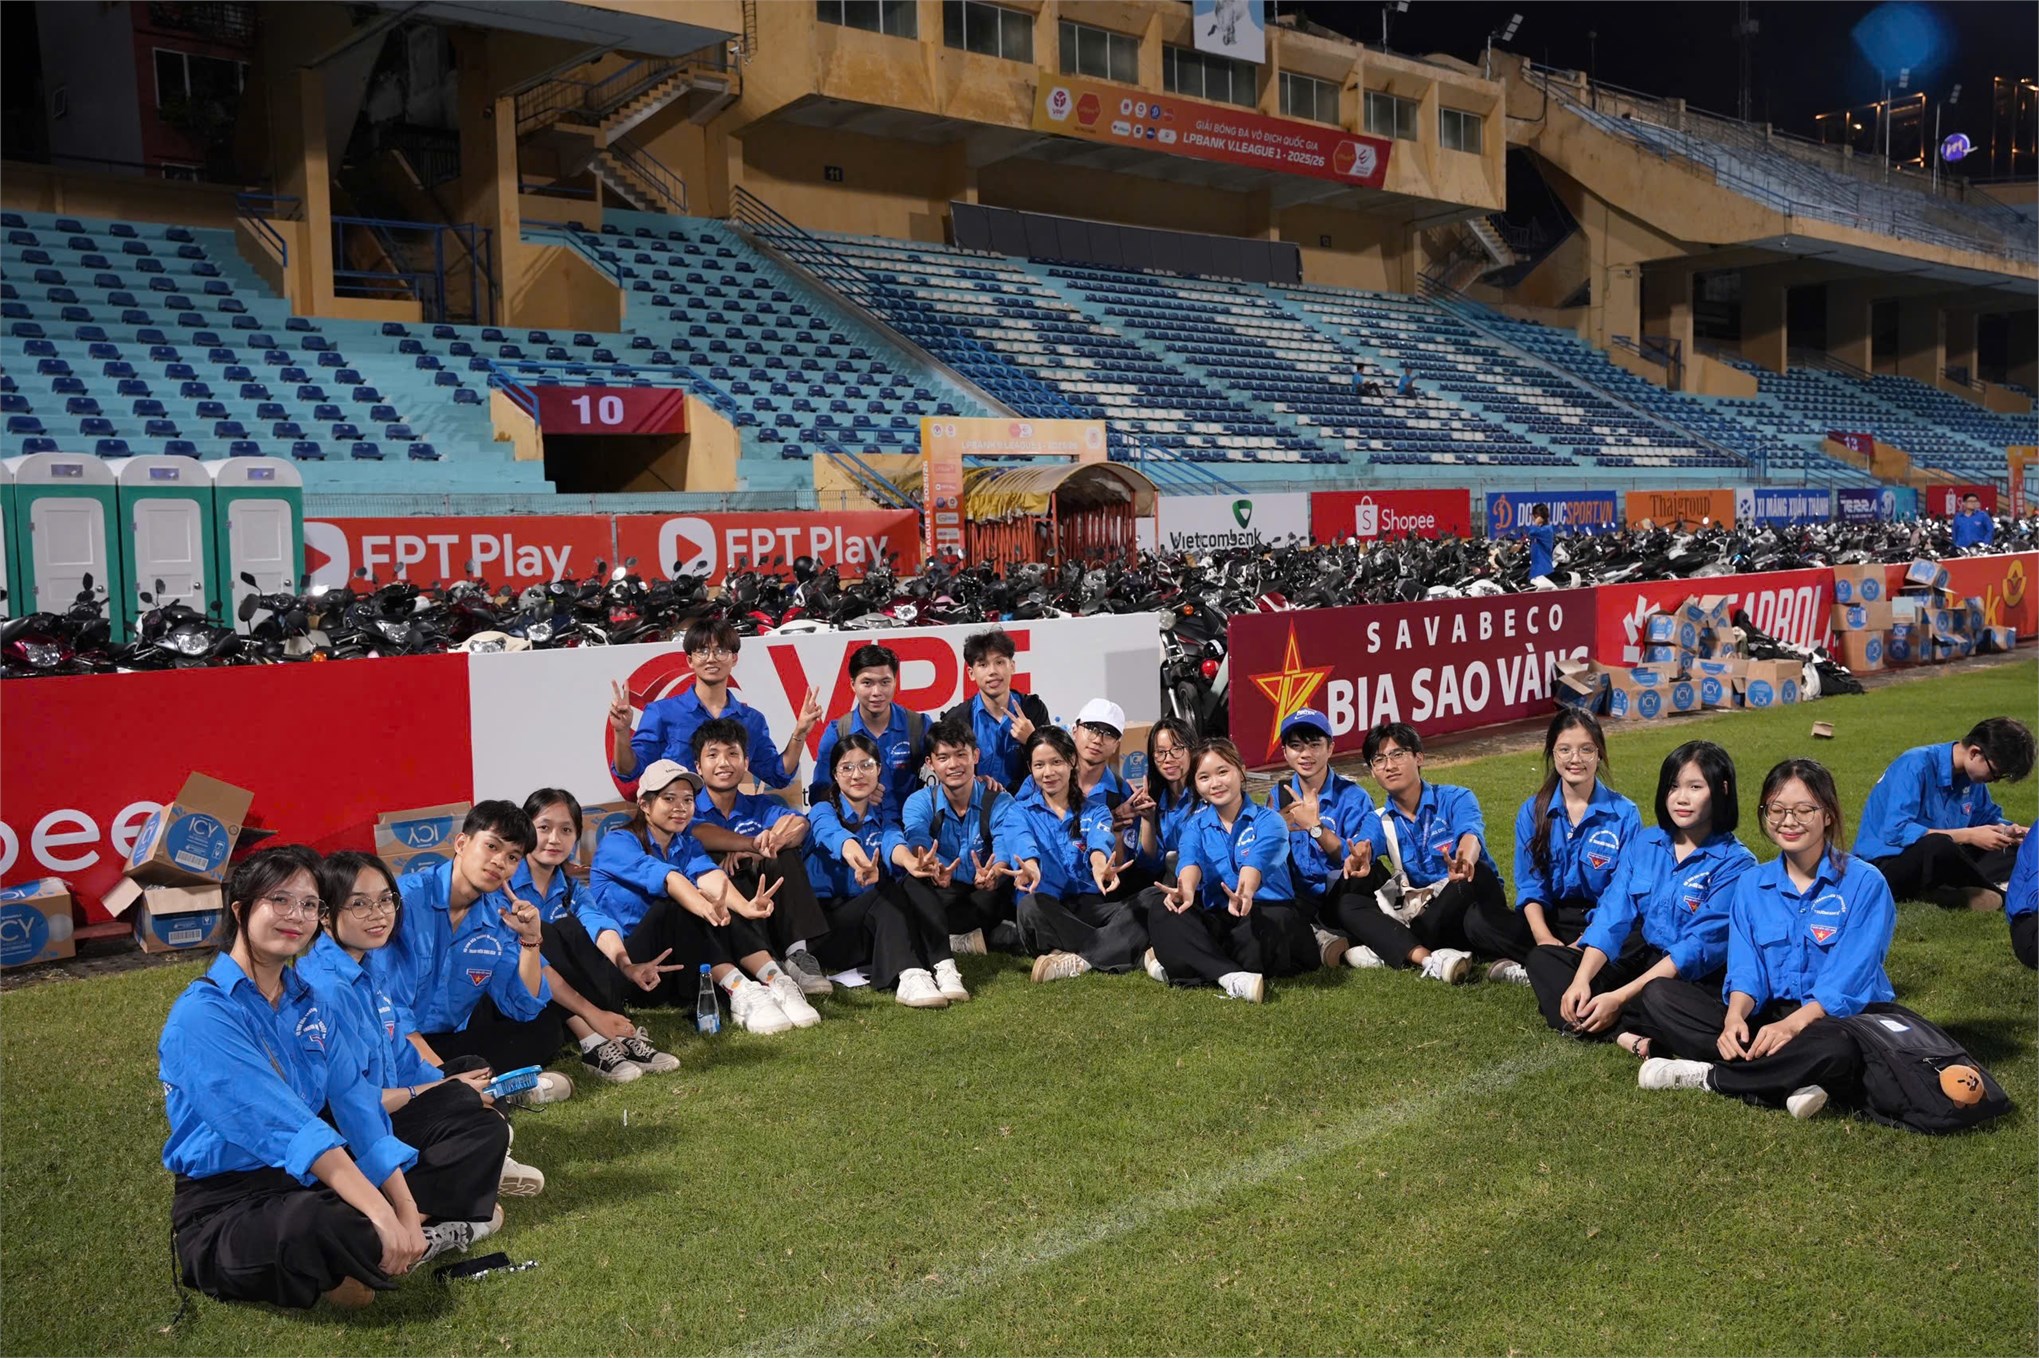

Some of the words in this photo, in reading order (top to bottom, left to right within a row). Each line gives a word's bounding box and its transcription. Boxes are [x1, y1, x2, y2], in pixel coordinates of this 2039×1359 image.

[1196, 120, 1213, 131] GIẢI
[1214, 123, 1237, 136] BÓNG
[1238, 127, 1249, 138] ĐÁ
[1264, 132, 1282, 145] ĐỊCH
[1283, 134, 1304, 148] QUỐC
[1306, 140, 1319, 150] GIA
[1183, 132, 1225, 149] LPBANK
[1228, 140, 1275, 158] V.LEAGUE
[1276, 149, 1281, 159] 1
[1287, 150, 1326, 167] 2025/26
[571, 394, 624, 426] 10
[1381, 508, 1435, 532] Shopee
[725, 527, 801, 569] FPT
[809, 526, 889, 569] Play
[1169, 527, 1262, 550] Vietcombank
[361, 534, 460, 582] FPT
[471, 533, 573, 584] Play
[1366, 602, 1564, 654] SAVABECO
[1326, 672, 1402, 737] BIA
[1410, 659, 1491, 722] SAO
[1676, 688, 1691, 700] ICY
[1702, 681, 1719, 694] ICY
[1642, 696, 1657, 707] ICY
[189, 817, 219, 838] ICY
[408, 824, 439, 845] ICY
[0, 916, 35, 941] CY
